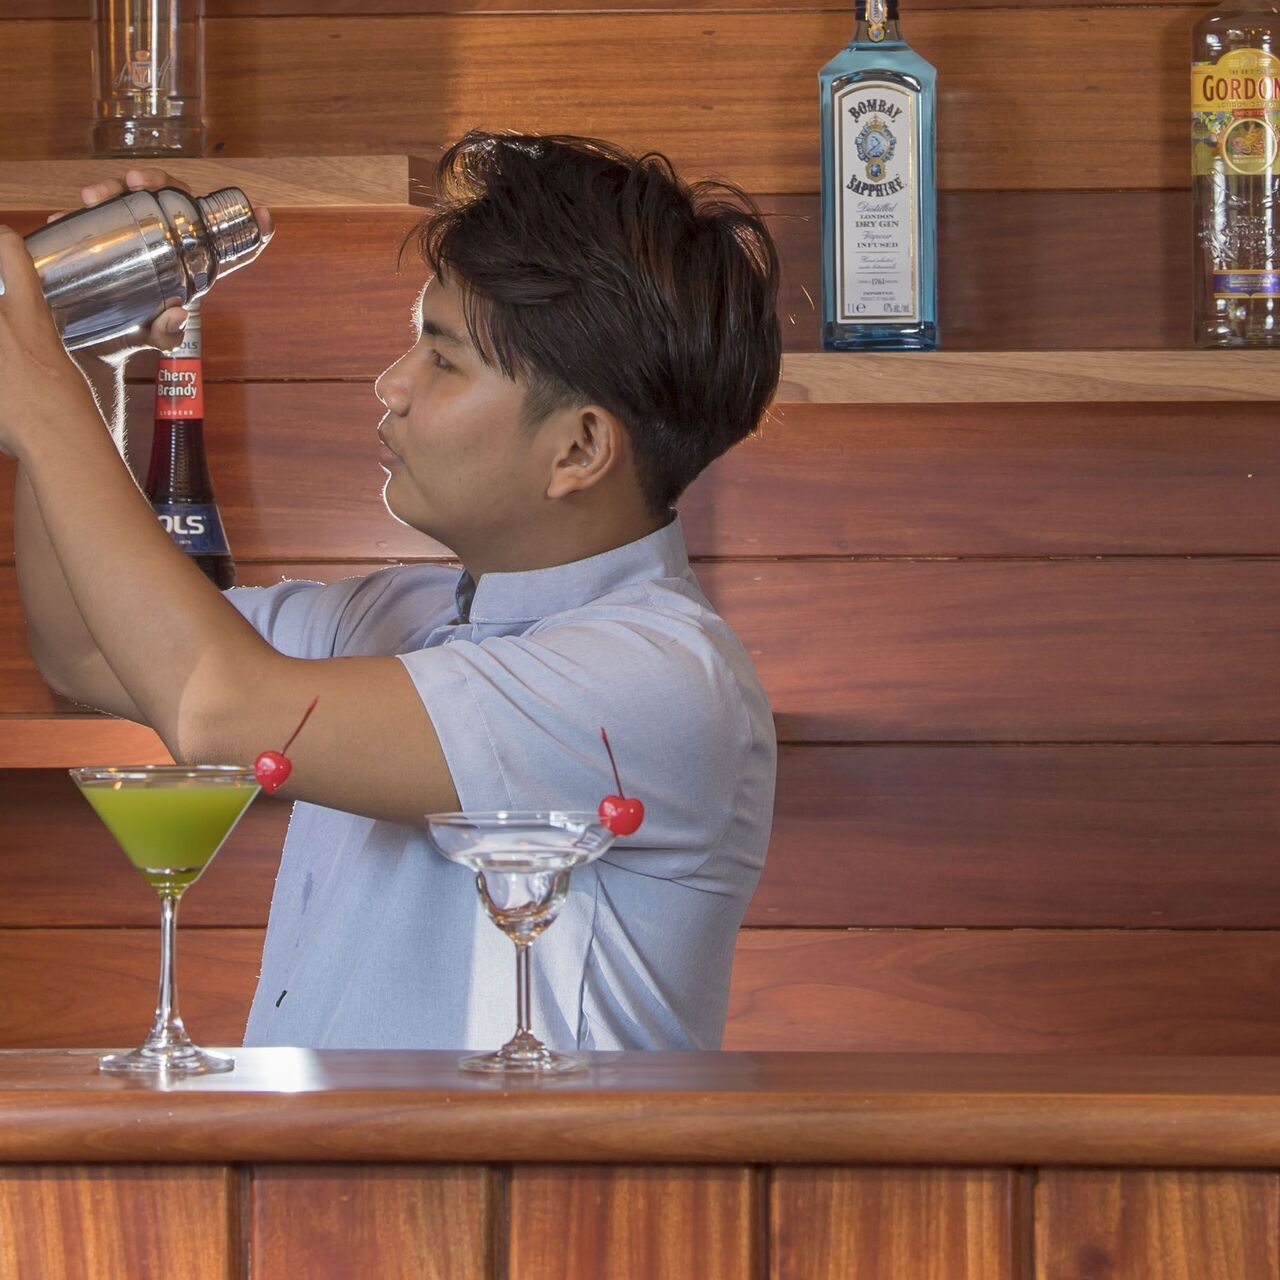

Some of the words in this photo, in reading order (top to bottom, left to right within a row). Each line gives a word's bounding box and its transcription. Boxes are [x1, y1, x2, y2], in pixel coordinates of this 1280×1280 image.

[848, 99, 902, 123] BOMBAY
[846, 174, 905, 198] SAPPHIRE
[181, 341, 198, 350] OLS
[158, 369, 197, 384] Cherry
[158, 384, 197, 399] Brandy
[158, 514, 205, 535] OLS
